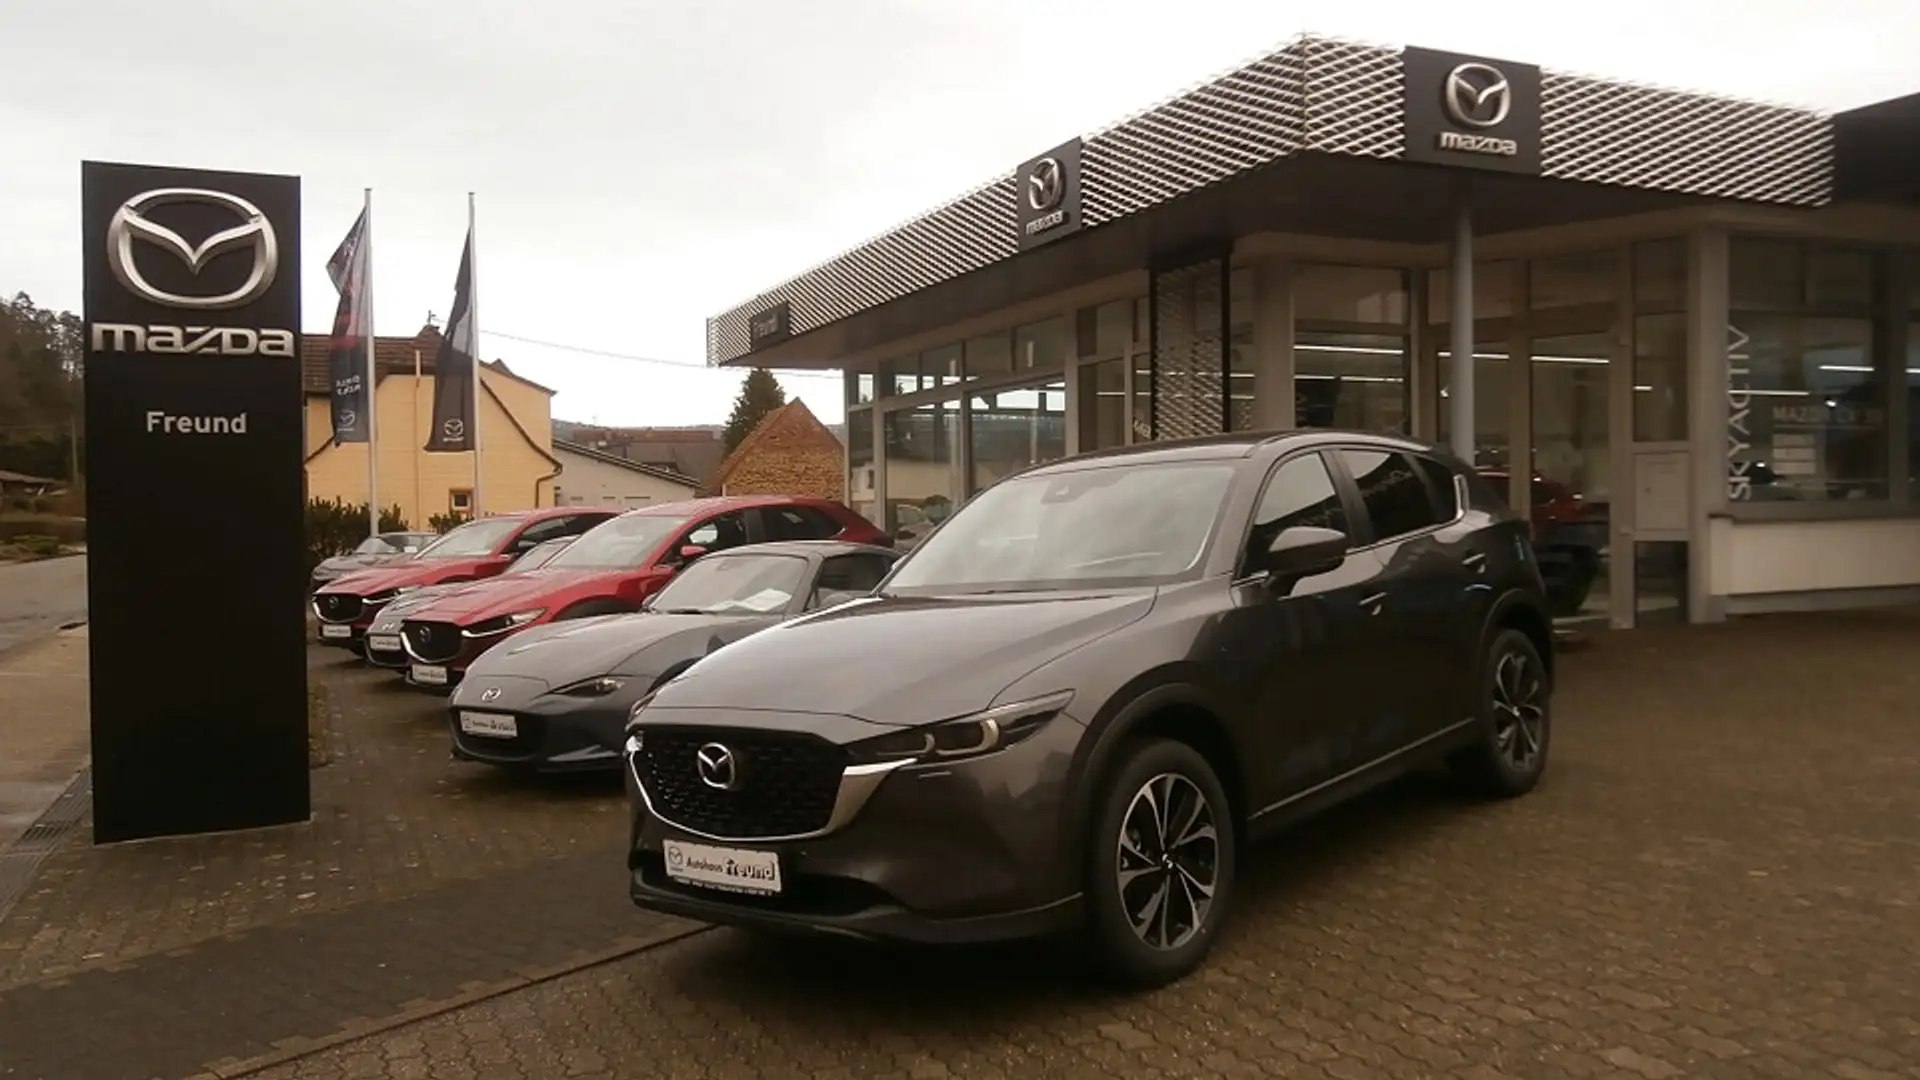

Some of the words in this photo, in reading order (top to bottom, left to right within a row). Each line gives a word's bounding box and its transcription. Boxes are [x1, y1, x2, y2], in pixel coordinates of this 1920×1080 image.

[91, 322, 295, 358] mazda
[145, 411, 247, 434] Freund
[1727, 325, 1750, 500] SKYACTIV
